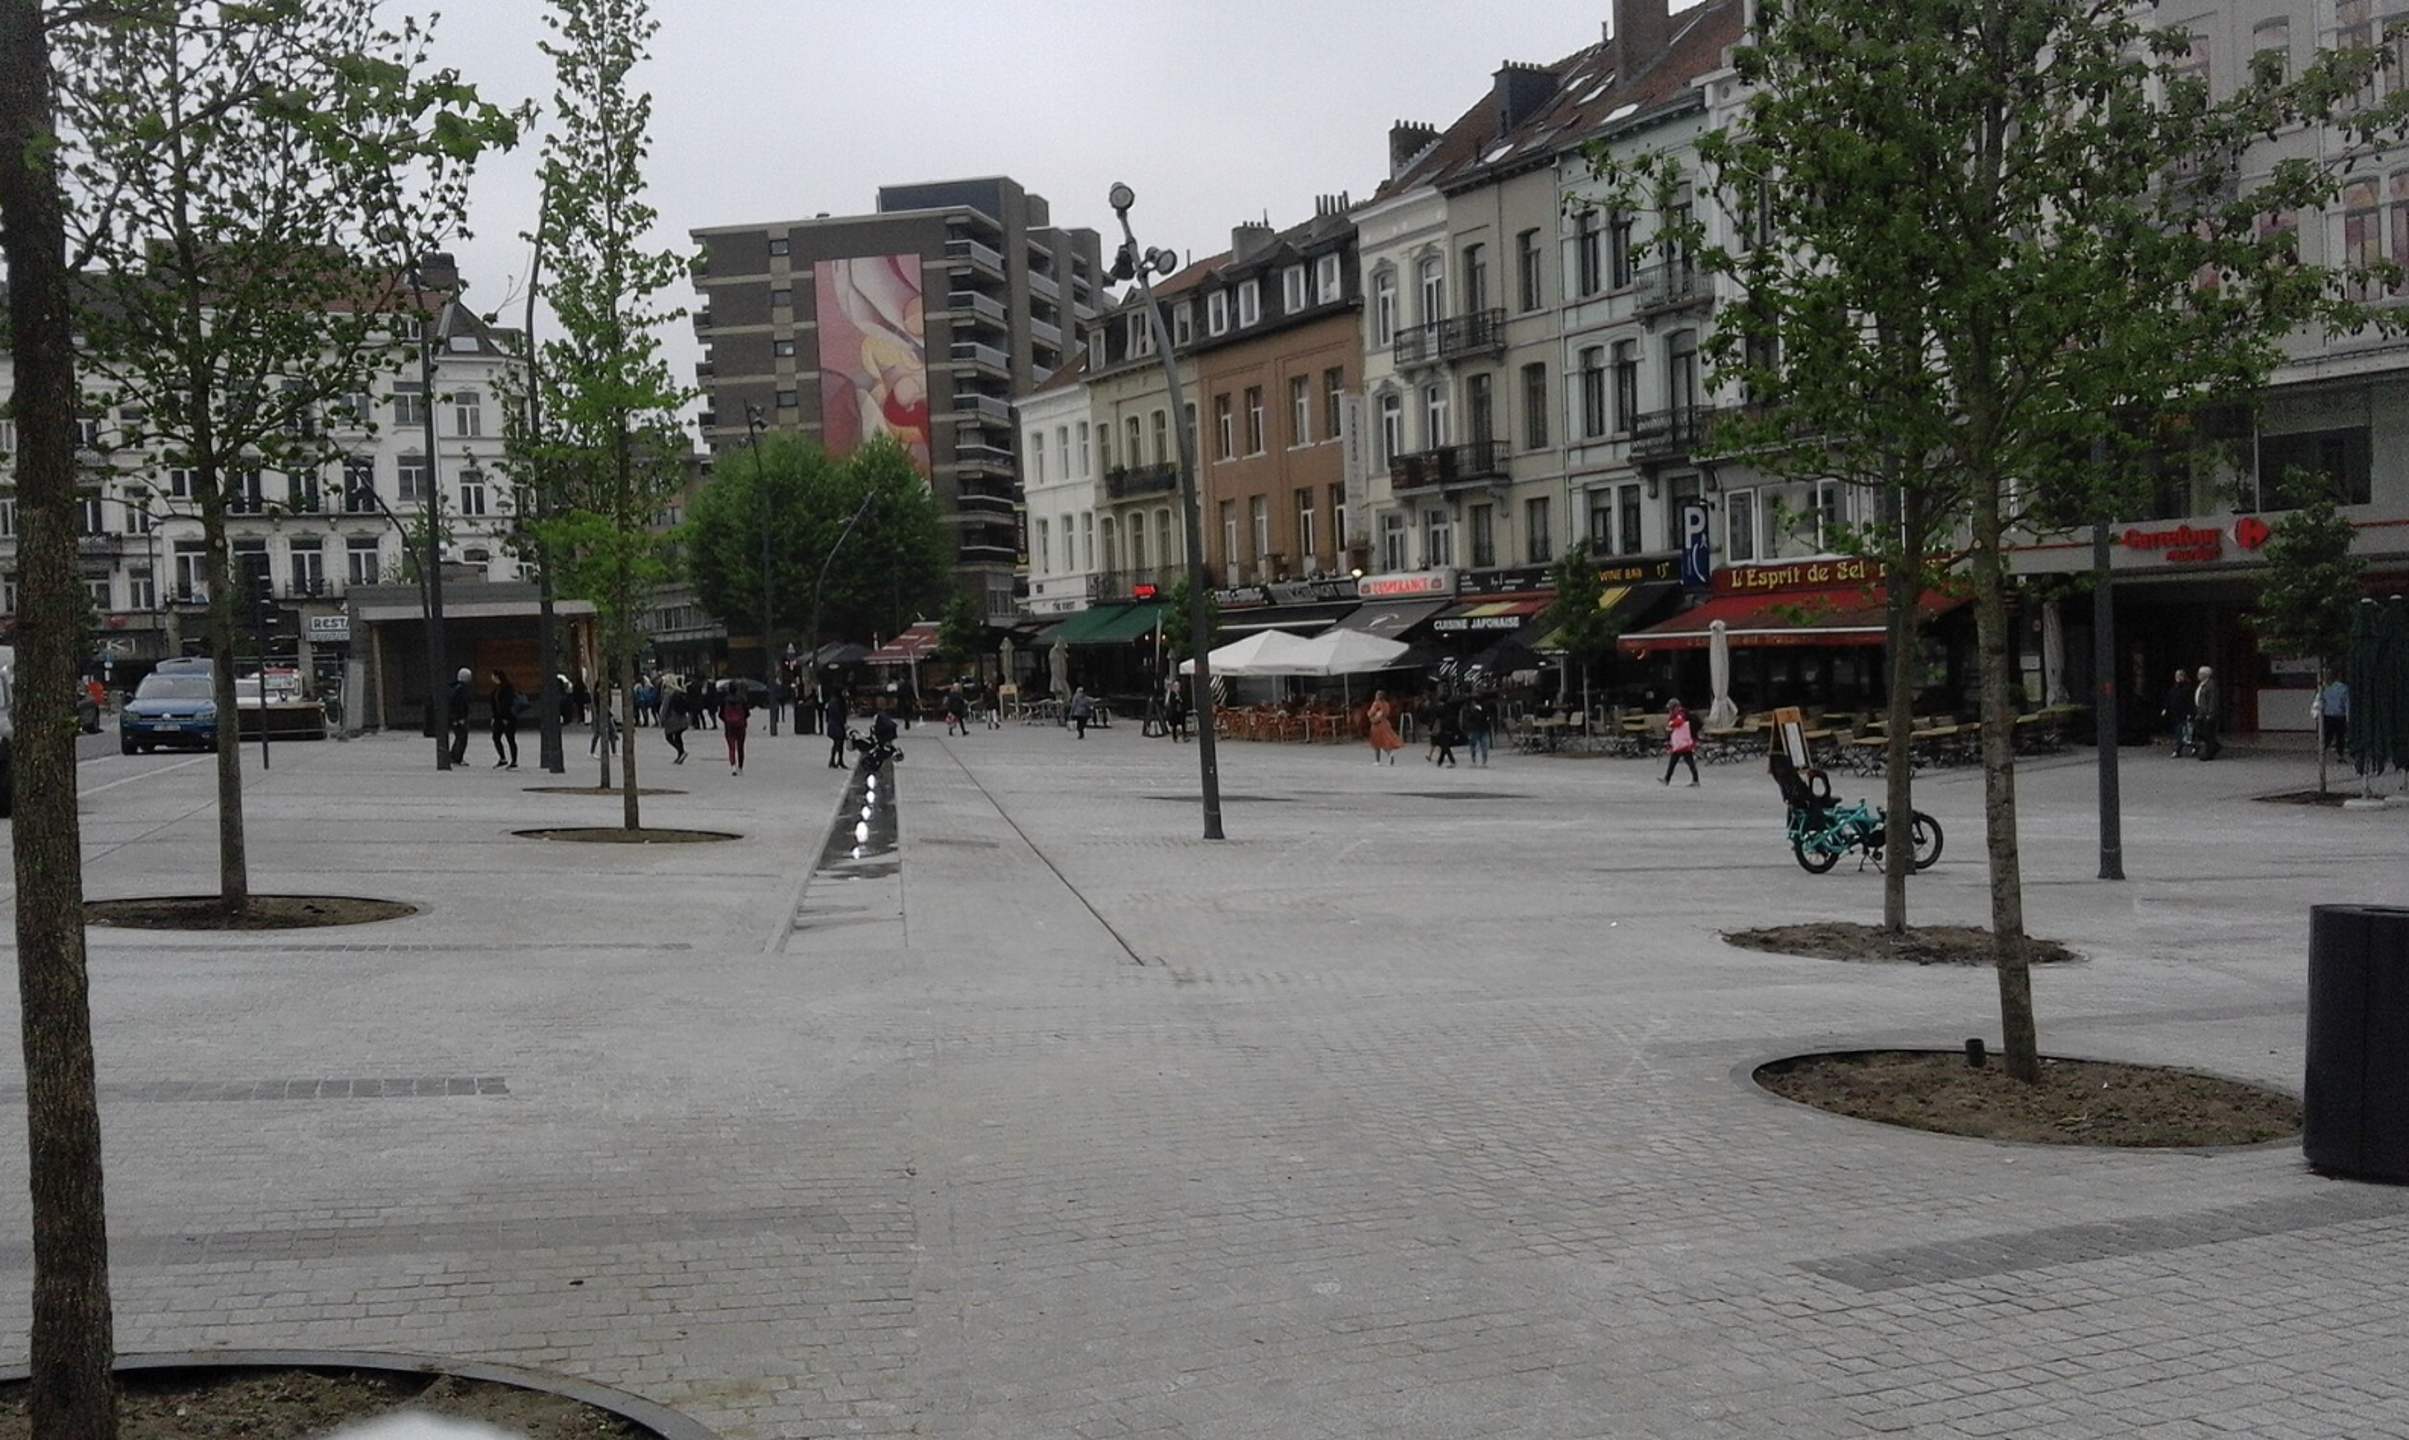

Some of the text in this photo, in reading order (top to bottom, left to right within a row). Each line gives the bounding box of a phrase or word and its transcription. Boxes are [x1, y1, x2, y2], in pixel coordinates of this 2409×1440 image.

[1684, 506, 1706, 550] P
[2122, 525, 2221, 549] Carrefour
[1731, 565, 1800, 591] L'Esprit
[1807, 563, 1829, 582] de
[1836, 560, 1866, 581] Sel
[1433, 615, 1520, 631] CUISINE JAPONAISE
